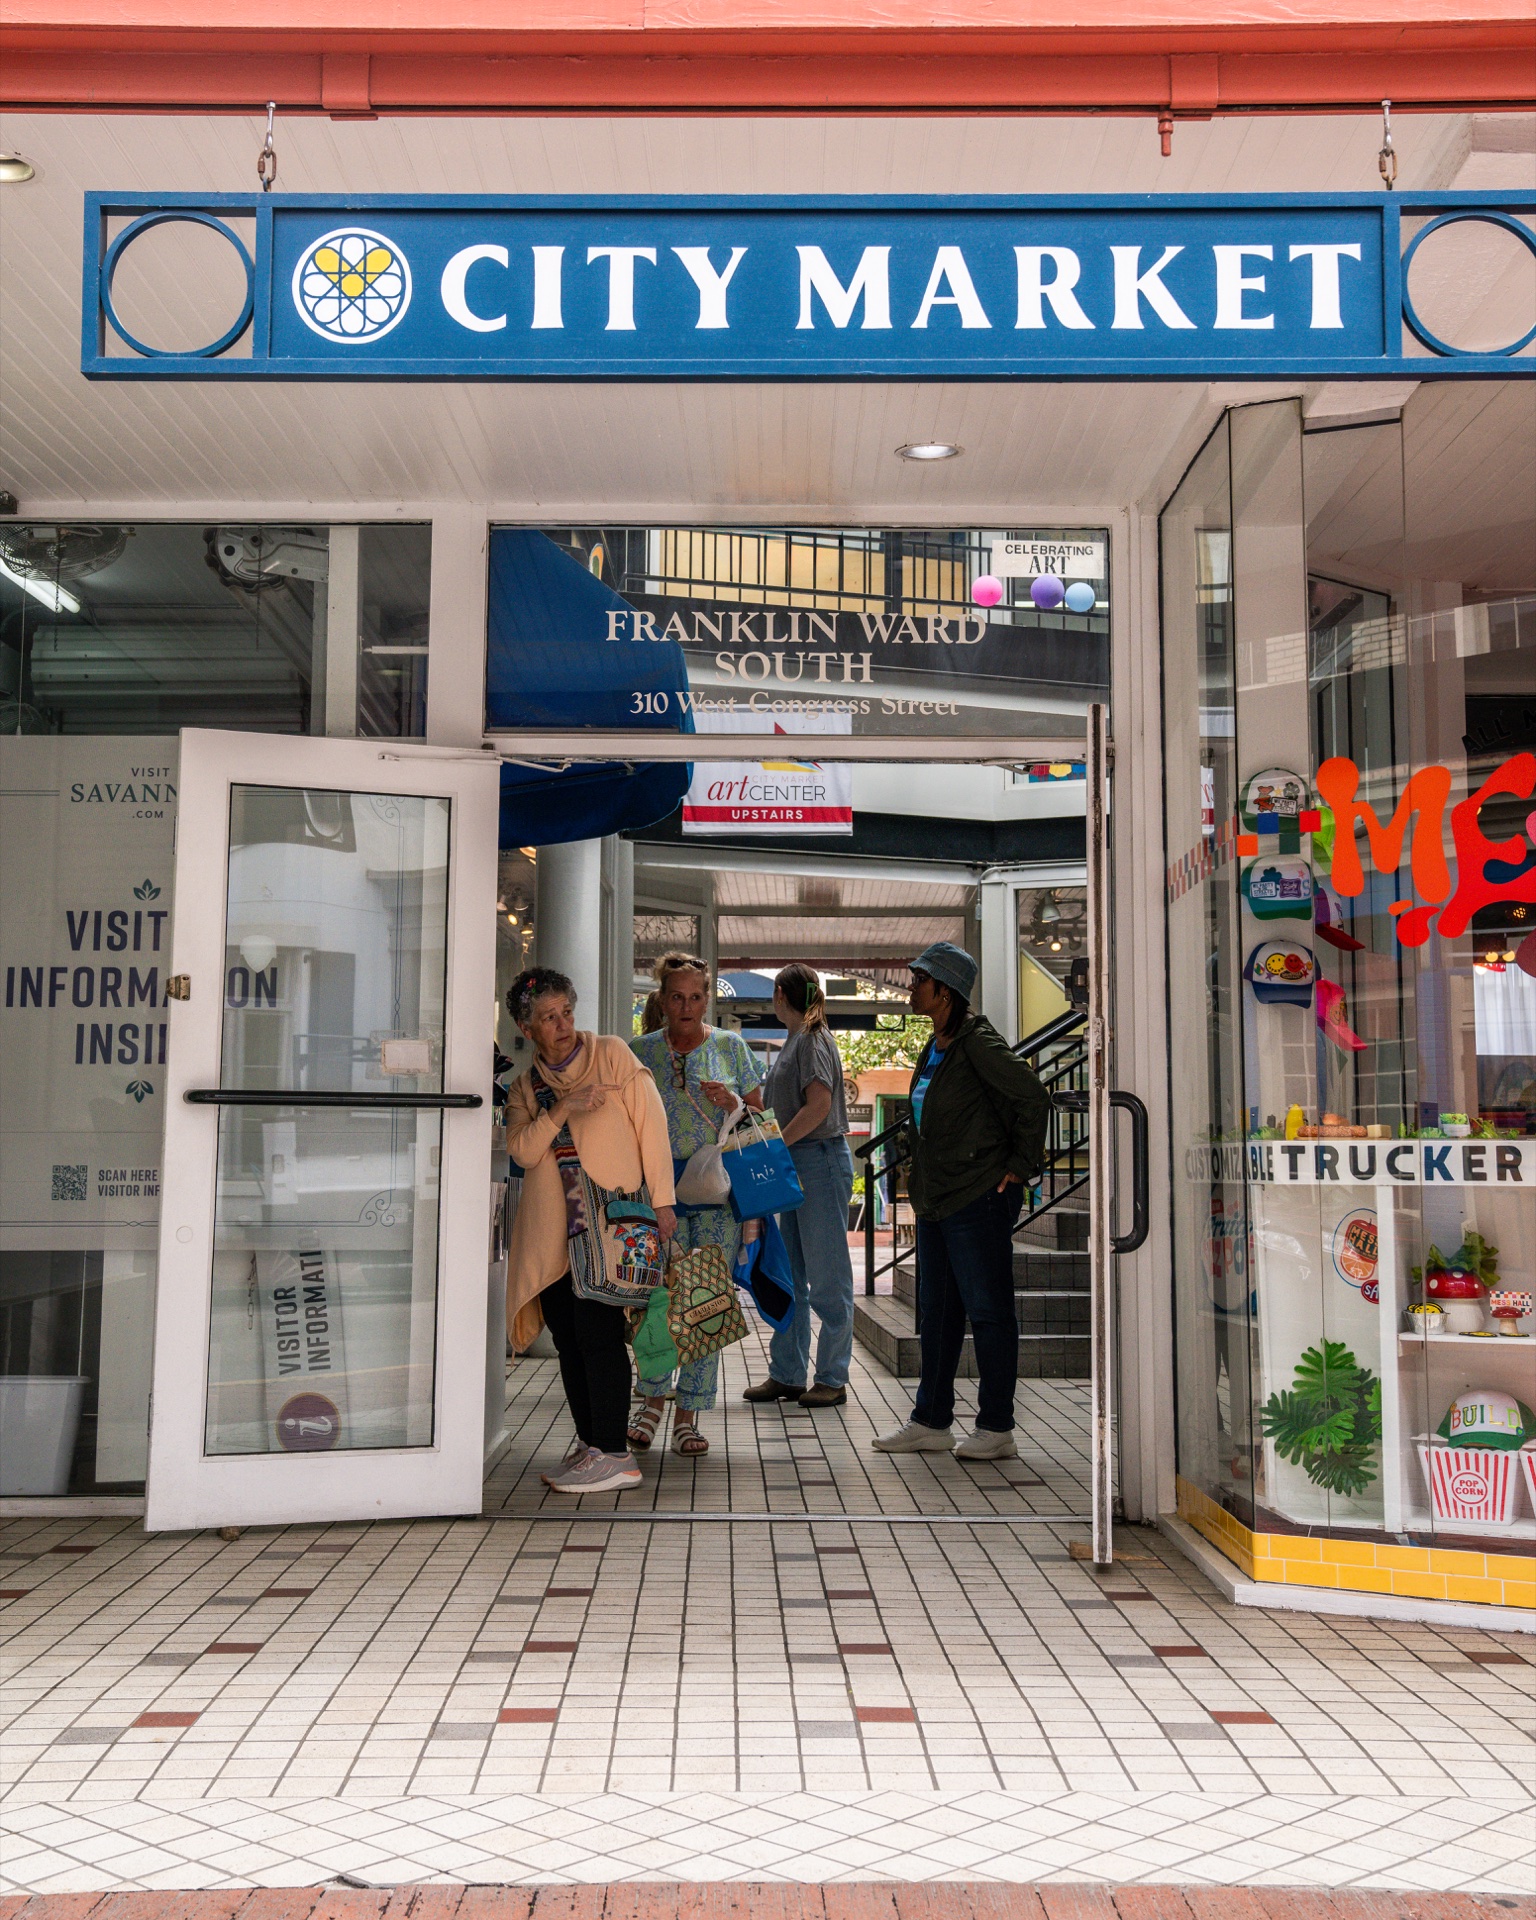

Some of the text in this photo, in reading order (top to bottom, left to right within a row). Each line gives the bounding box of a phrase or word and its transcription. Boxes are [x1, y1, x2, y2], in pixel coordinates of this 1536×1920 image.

[440, 243, 1362, 333] CITY MARKET
[1005, 544, 1094, 556] CELEBRATING
[1029, 555, 1071, 574] ART
[605, 610, 987, 644] FRANKLIN WARD
[715, 651, 874, 683] SOUTH
[629, 690, 960, 721] 310 West Congress Street
[131, 767, 170, 778] VISIT
[752, 775, 826, 784] CITY MARKET
[132, 810, 164, 819] .COM
[731, 809, 804, 820] UPSTAIRS
[66, 910, 168, 951] VISIT
[1281, 1145, 1524, 1182] TRUCKER
[98, 1169, 158, 1182] SCAN HERE
[98, 1184, 140, 1197] VISITOR
[273, 1286, 301, 1376] VISITOR
[1451, 1404, 1521, 1431] BUILD
[1455, 1486, 1484, 1496] CORN
[1459, 1479, 1479, 1488] POP
